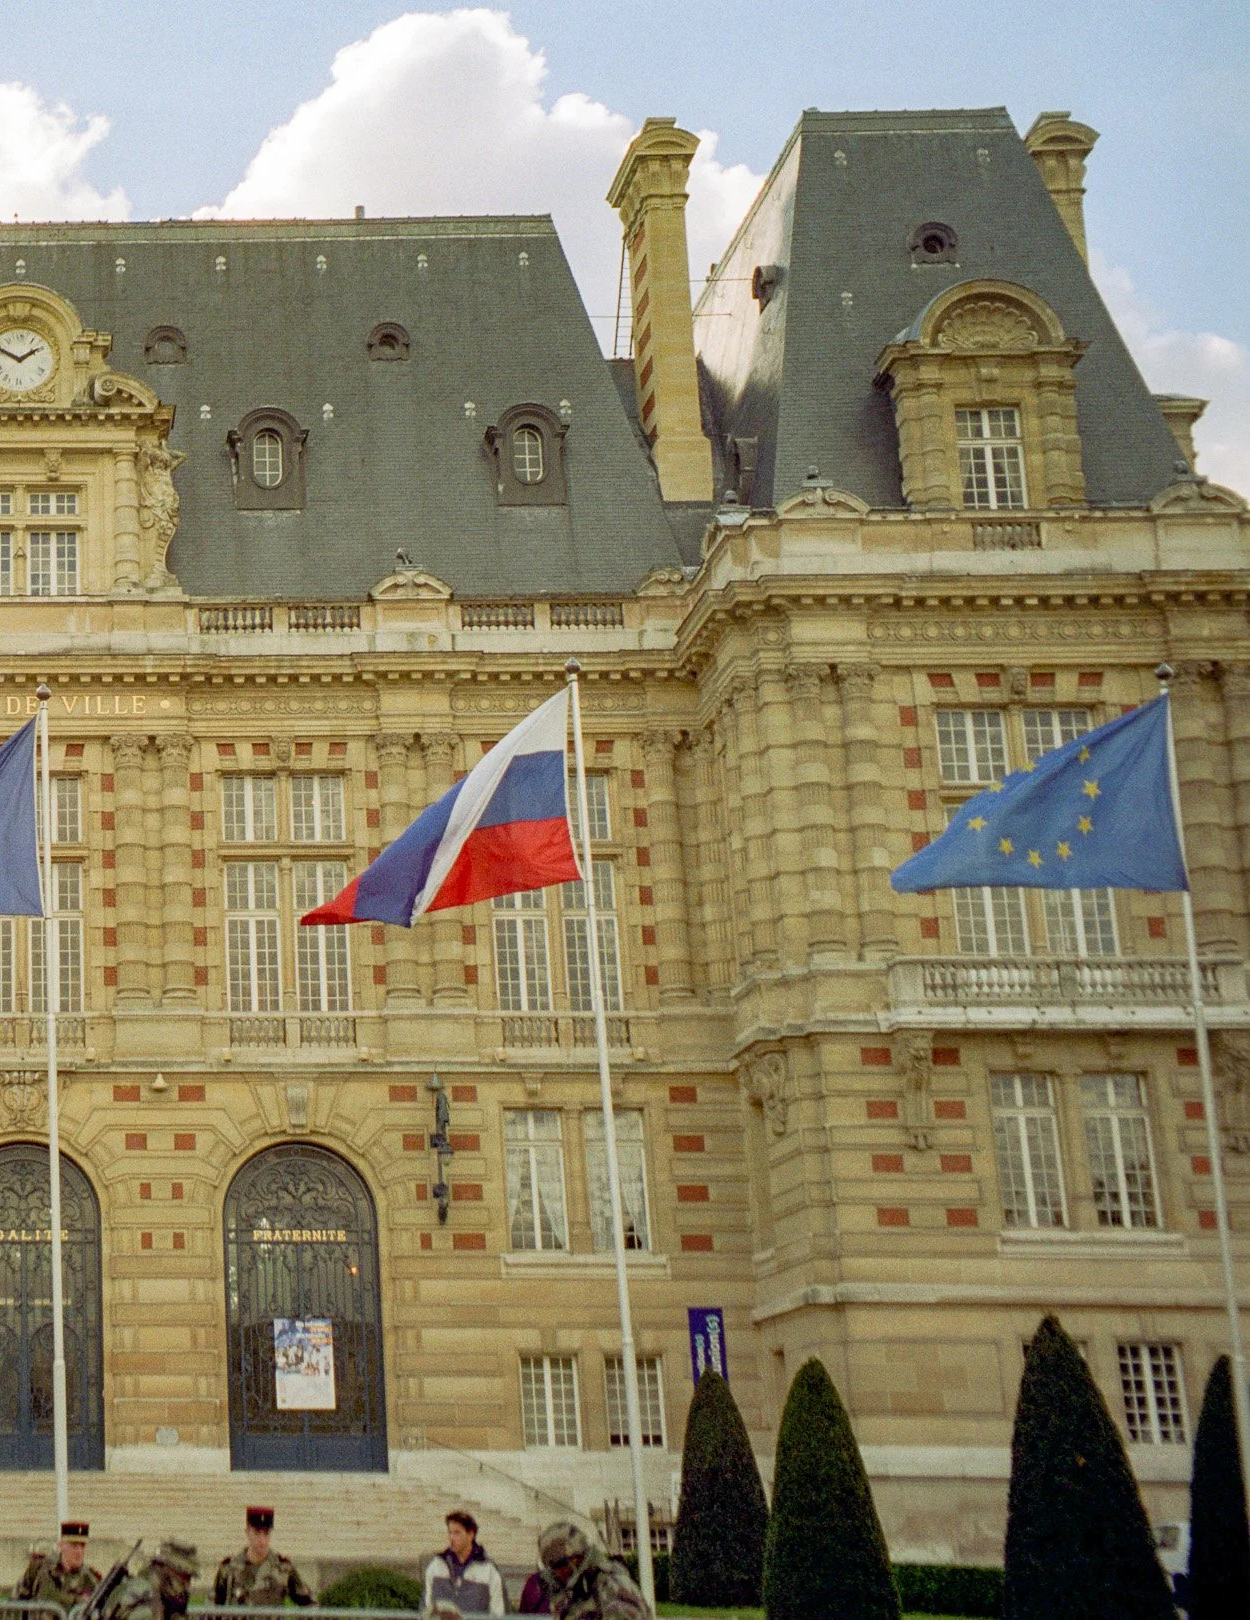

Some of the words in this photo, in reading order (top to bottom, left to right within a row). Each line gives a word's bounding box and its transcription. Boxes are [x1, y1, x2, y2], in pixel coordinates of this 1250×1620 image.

[6, 696, 39, 715] DE
[62, 695, 147, 714] VILLE
[252, 1229, 347, 1242] FRATERNITE
